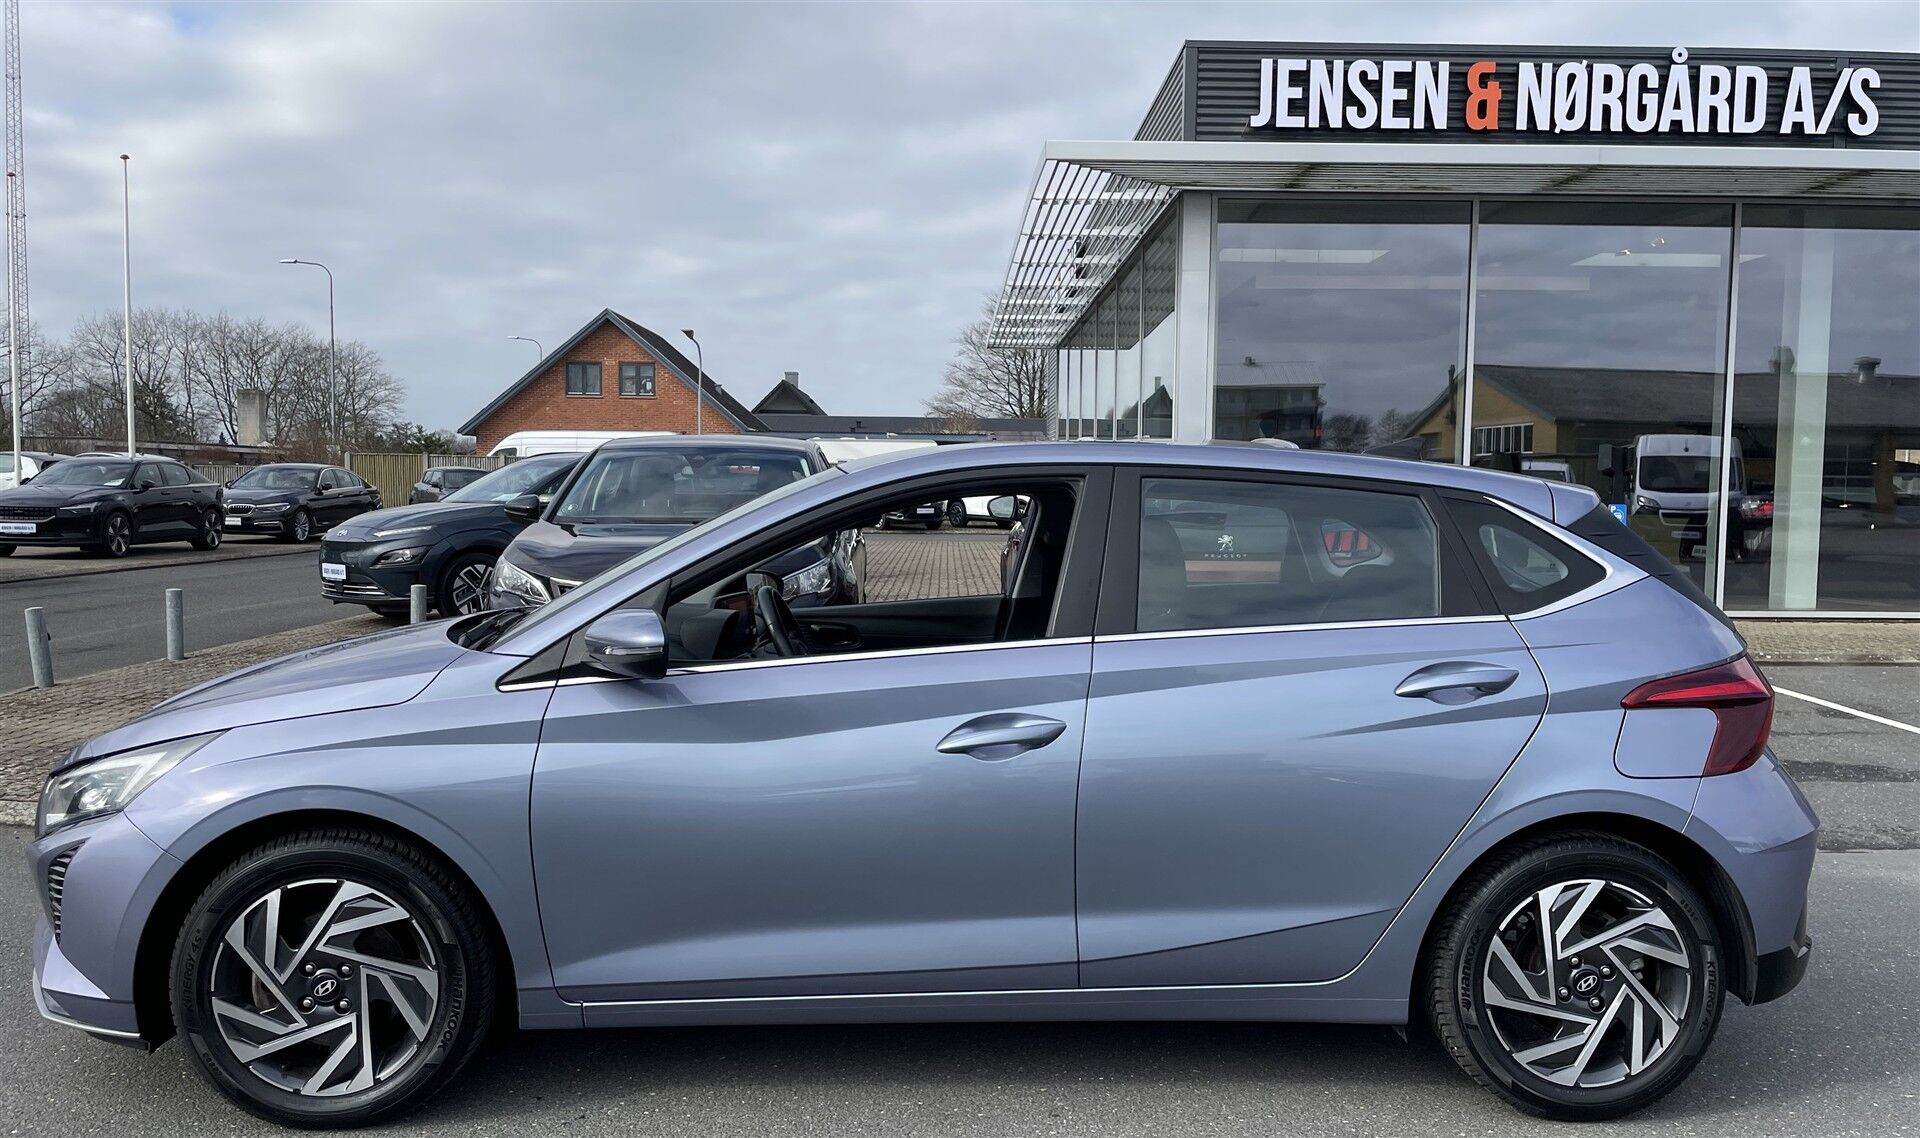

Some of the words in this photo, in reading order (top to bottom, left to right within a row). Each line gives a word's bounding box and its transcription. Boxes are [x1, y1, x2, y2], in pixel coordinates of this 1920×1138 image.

[1250, 58, 1450, 130] JENSEN
[1465, 61, 1502, 131] &
[1515, 46, 1768, 134] NØRGÅRD
[1779, 66, 1881, 136] A/S
